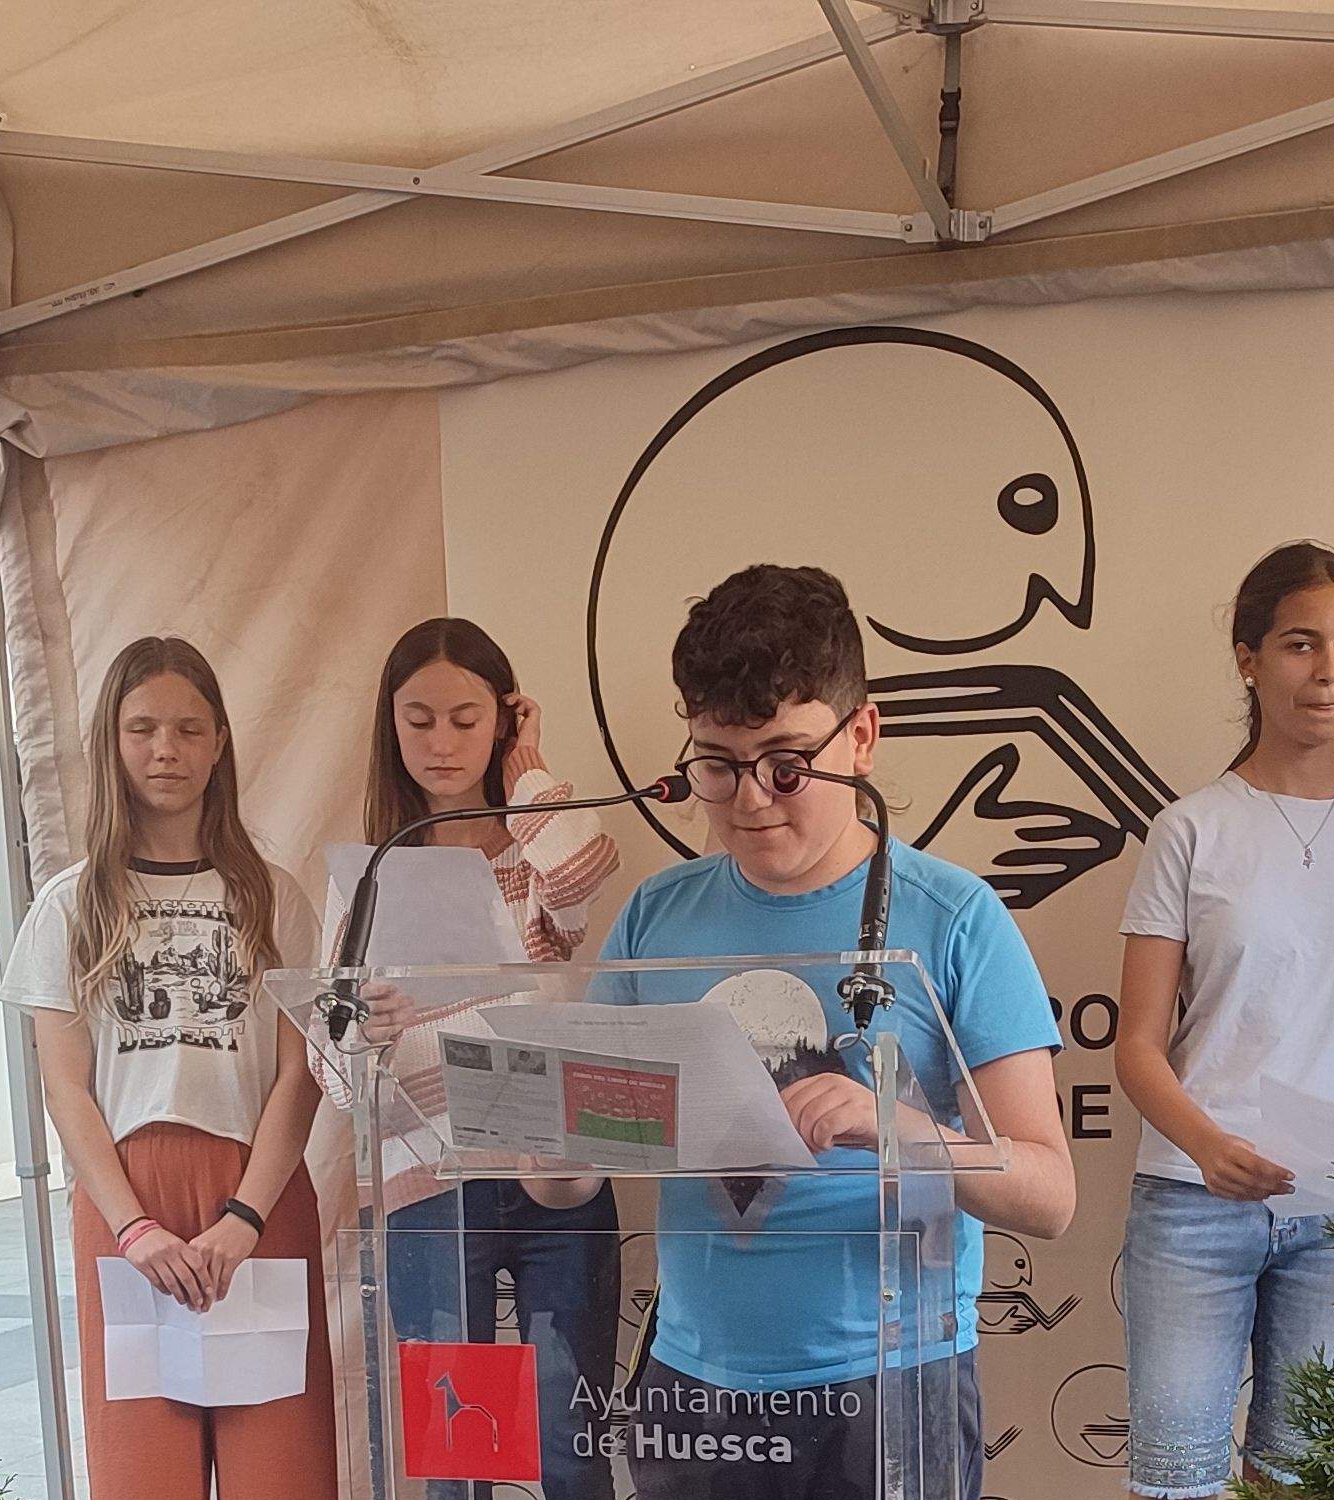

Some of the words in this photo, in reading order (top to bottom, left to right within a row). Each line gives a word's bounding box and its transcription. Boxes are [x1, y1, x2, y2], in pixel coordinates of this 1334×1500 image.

[116, 1020, 245, 1054] DESERT
[569, 1374, 862, 1421] Ayuntamiento
[572, 1421, 618, 1458] de
[634, 1423, 793, 1463] Huesca
